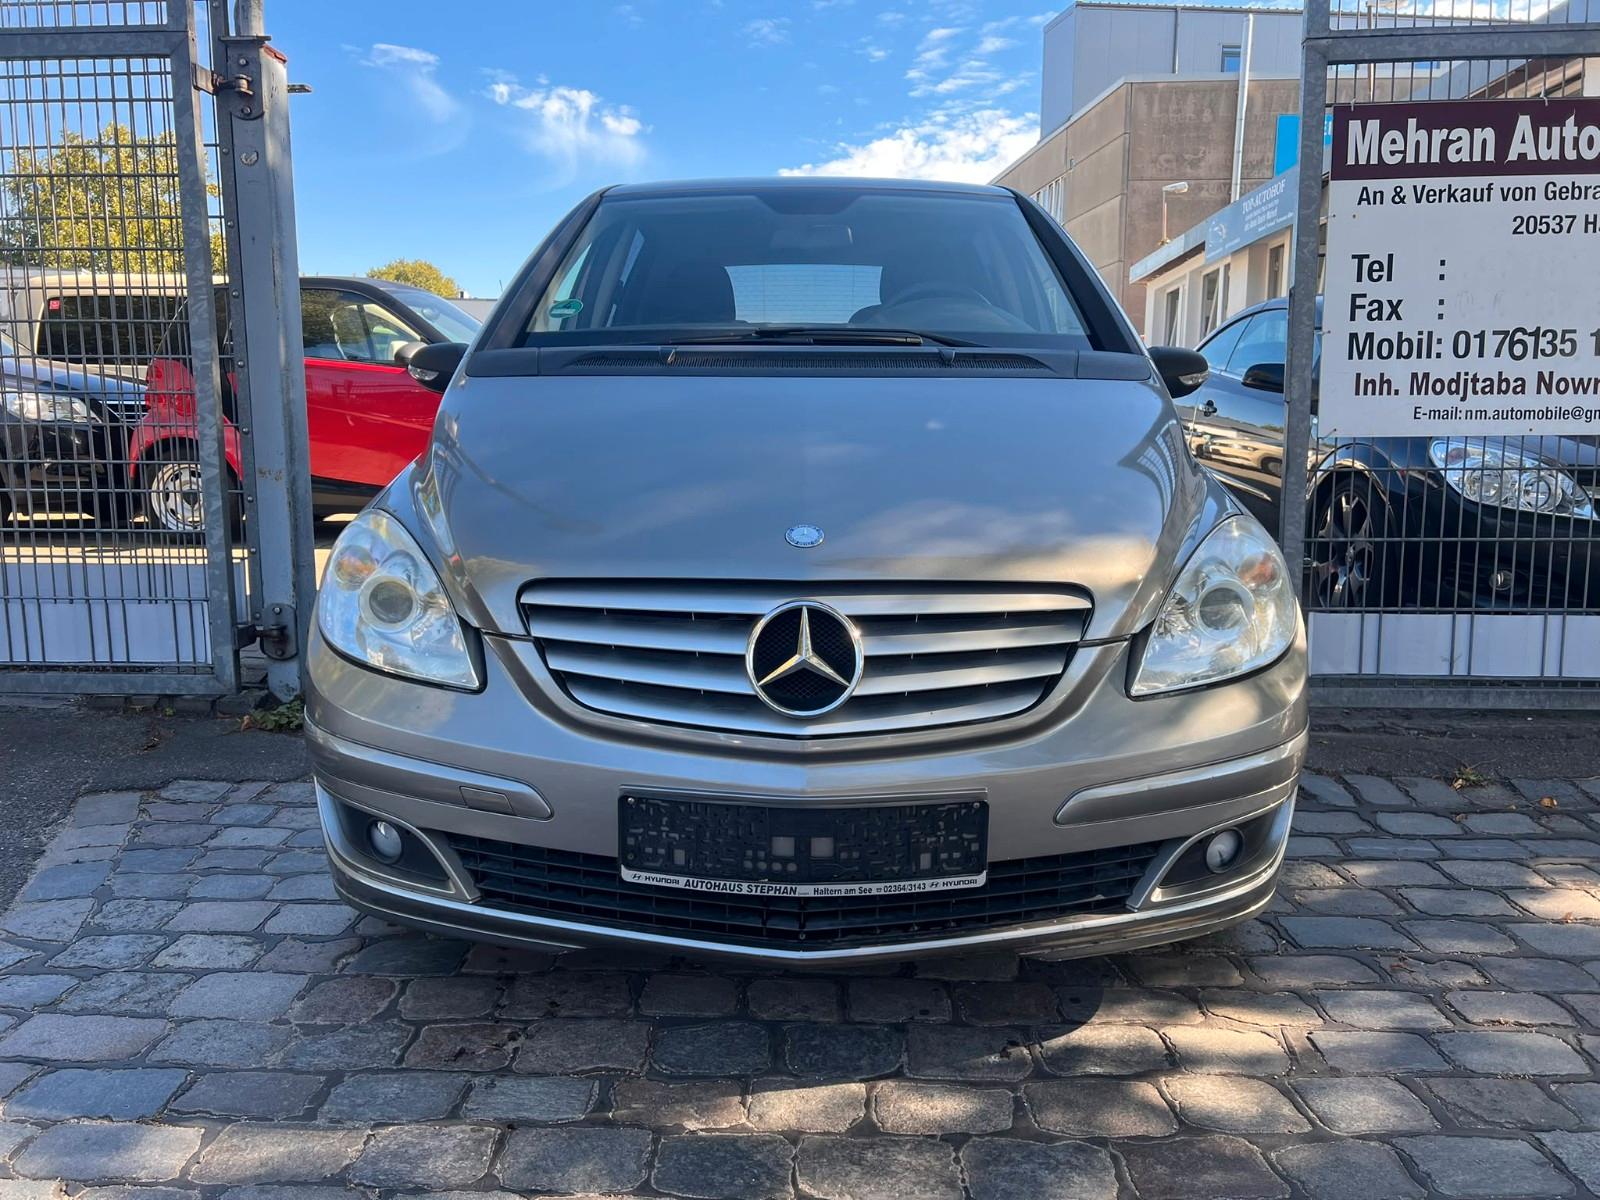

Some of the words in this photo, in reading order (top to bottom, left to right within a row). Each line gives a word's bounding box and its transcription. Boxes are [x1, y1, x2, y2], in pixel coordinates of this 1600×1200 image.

[1346, 118, 1496, 165] Mehran
[1504, 112, 1600, 163] Auto
[1357, 186, 1384, 205] An
[1391, 185, 1407, 205] &
[1413, 183, 1494, 203] Verkauf
[1500, 186, 1536, 202] von
[1512, 214, 1577, 235] 20537
[1584, 214, 1600, 234] H
[1351, 253, 1394, 283] Tel
[1349, 293, 1403, 322] Fax
[1348, 330, 1442, 360] Mobil:
[1354, 372, 1400, 396] Inh.
[1409, 371, 1526, 402] Modjtaba
[1413, 406, 1462, 420] E-mail:
[645, 875, 680, 885] HYUNDAI
[684, 879, 743, 893] AUTOHAUS
[746, 884, 798, 896] STEPHAN
[813, 887, 842, 896] Haltern
[858, 886, 873, 894] See
[942, 879, 977, 887] HYUNDAI
